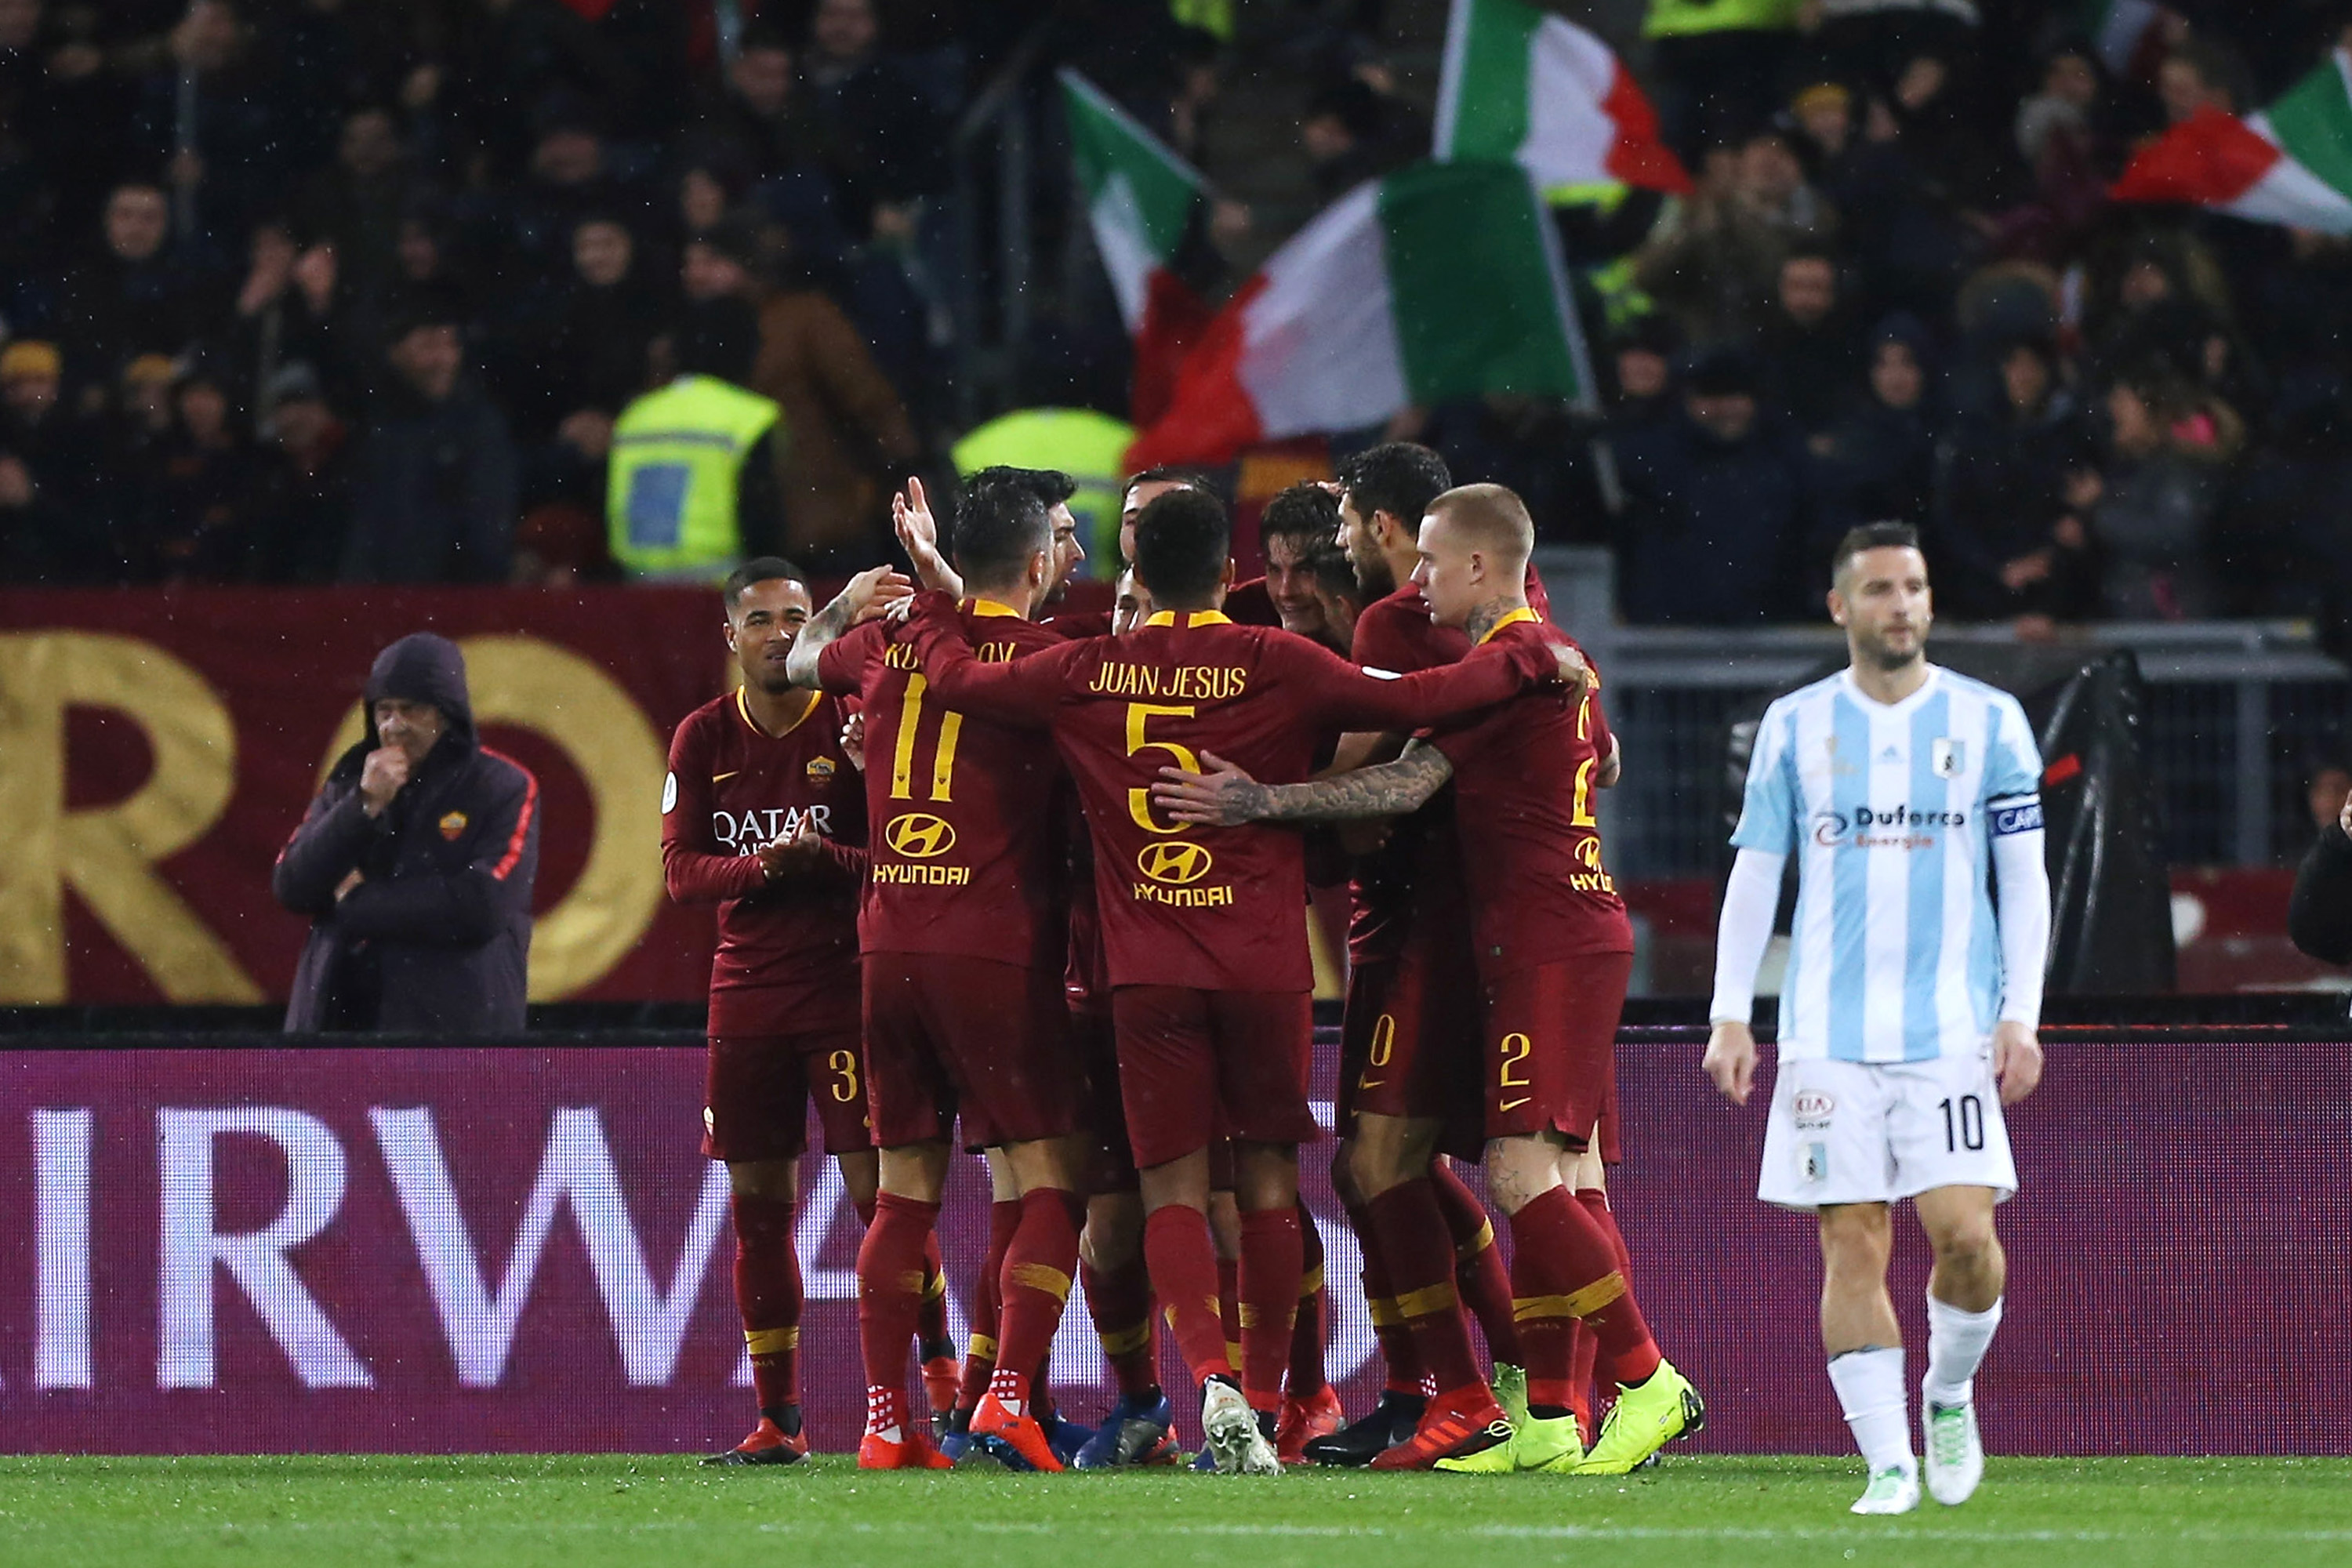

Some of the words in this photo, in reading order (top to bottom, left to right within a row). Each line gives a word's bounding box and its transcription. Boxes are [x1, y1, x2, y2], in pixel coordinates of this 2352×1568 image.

[1089, 661, 1160, 695] JUAN
[1162, 666, 1247, 699] JESUS
[889, 672, 964, 803] 11
[1126, 702, 1202, 834] 5
[713, 804, 833, 848] QATAR
[1855, 804, 1965, 826] Duferco
[872, 864, 971, 886] HYUNDAI
[1133, 882, 1234, 908] HYUNDAI
[1370, 1014, 1396, 1067] 0
[1500, 1032, 1531, 1087] 2
[829, 1050, 858, 1102] 3
[1938, 1094, 1984, 1153] 10
